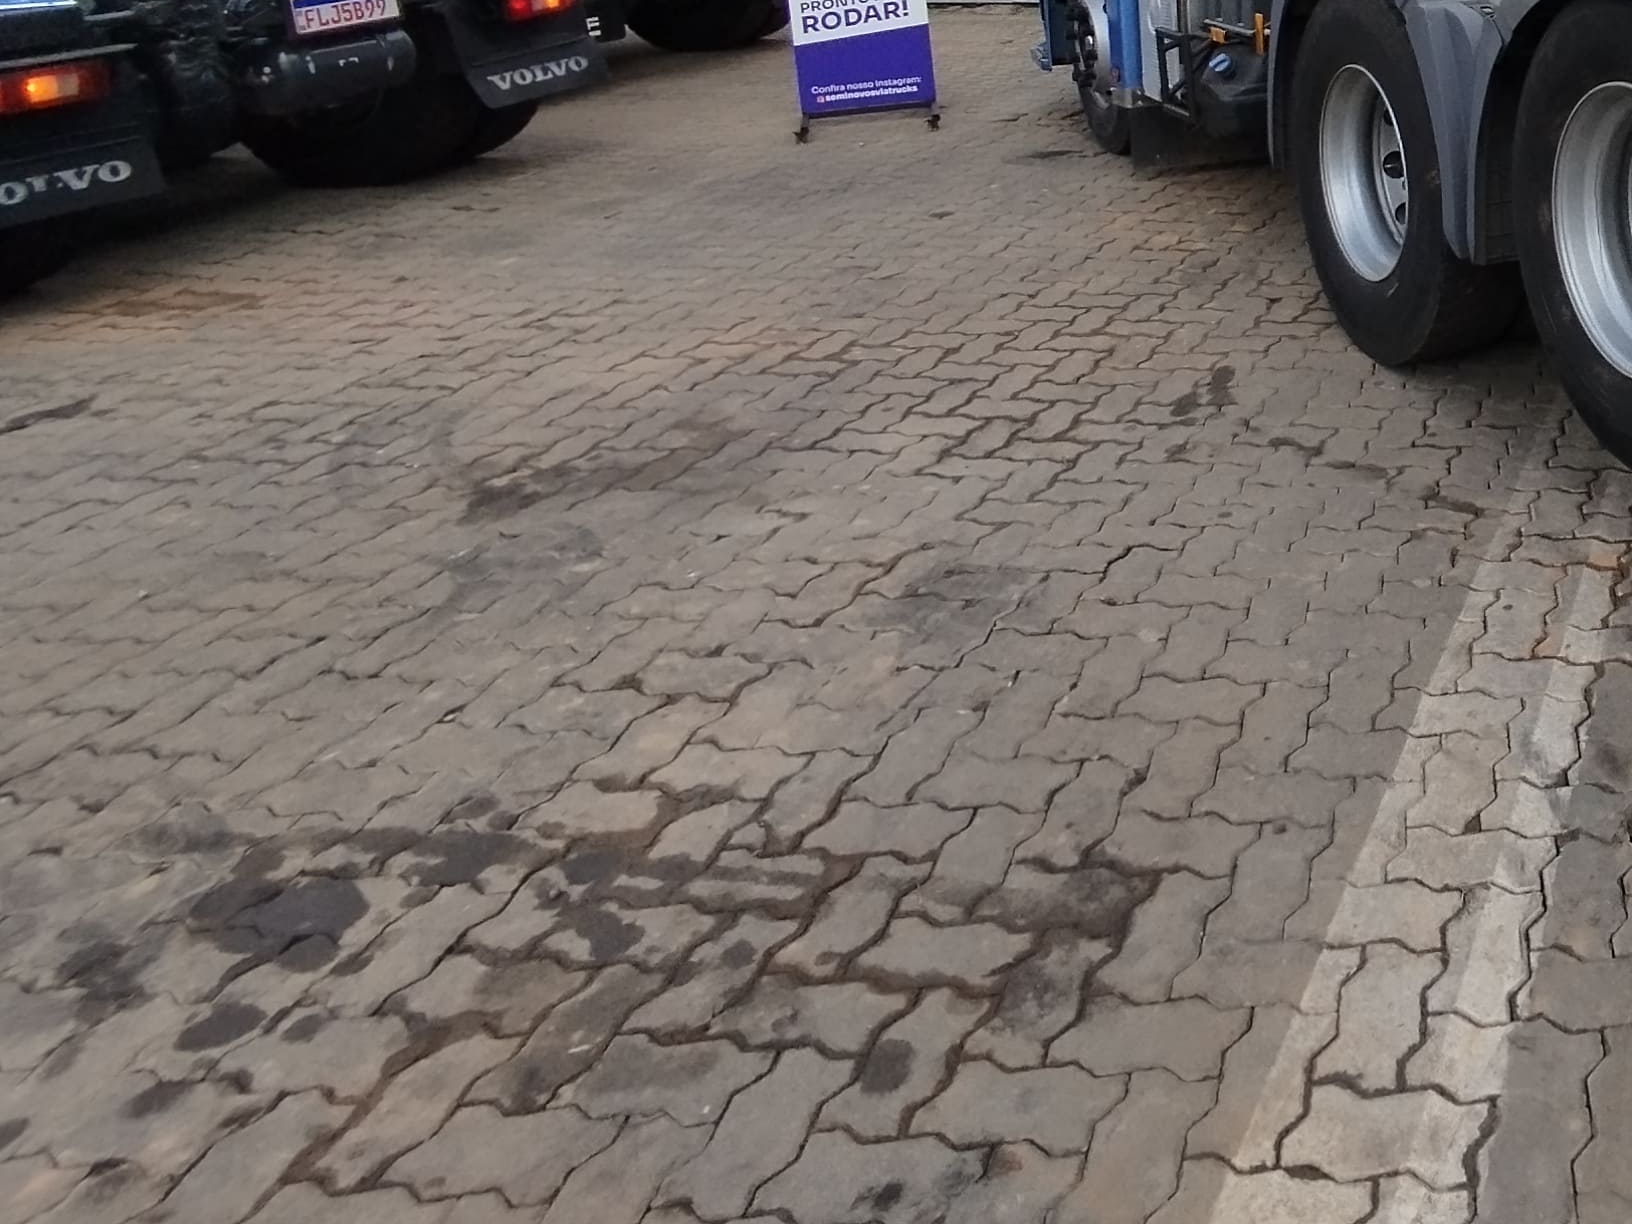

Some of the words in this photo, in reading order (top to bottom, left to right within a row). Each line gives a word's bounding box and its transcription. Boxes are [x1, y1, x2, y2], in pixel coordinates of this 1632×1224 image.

[801, 0, 910, 34] RODAR!
[486, 55, 589, 91] VOLVO
[811, 84, 846, 95] Confira
[847, 80, 874, 91] nosso
[0, 160, 132, 205] OLVO
